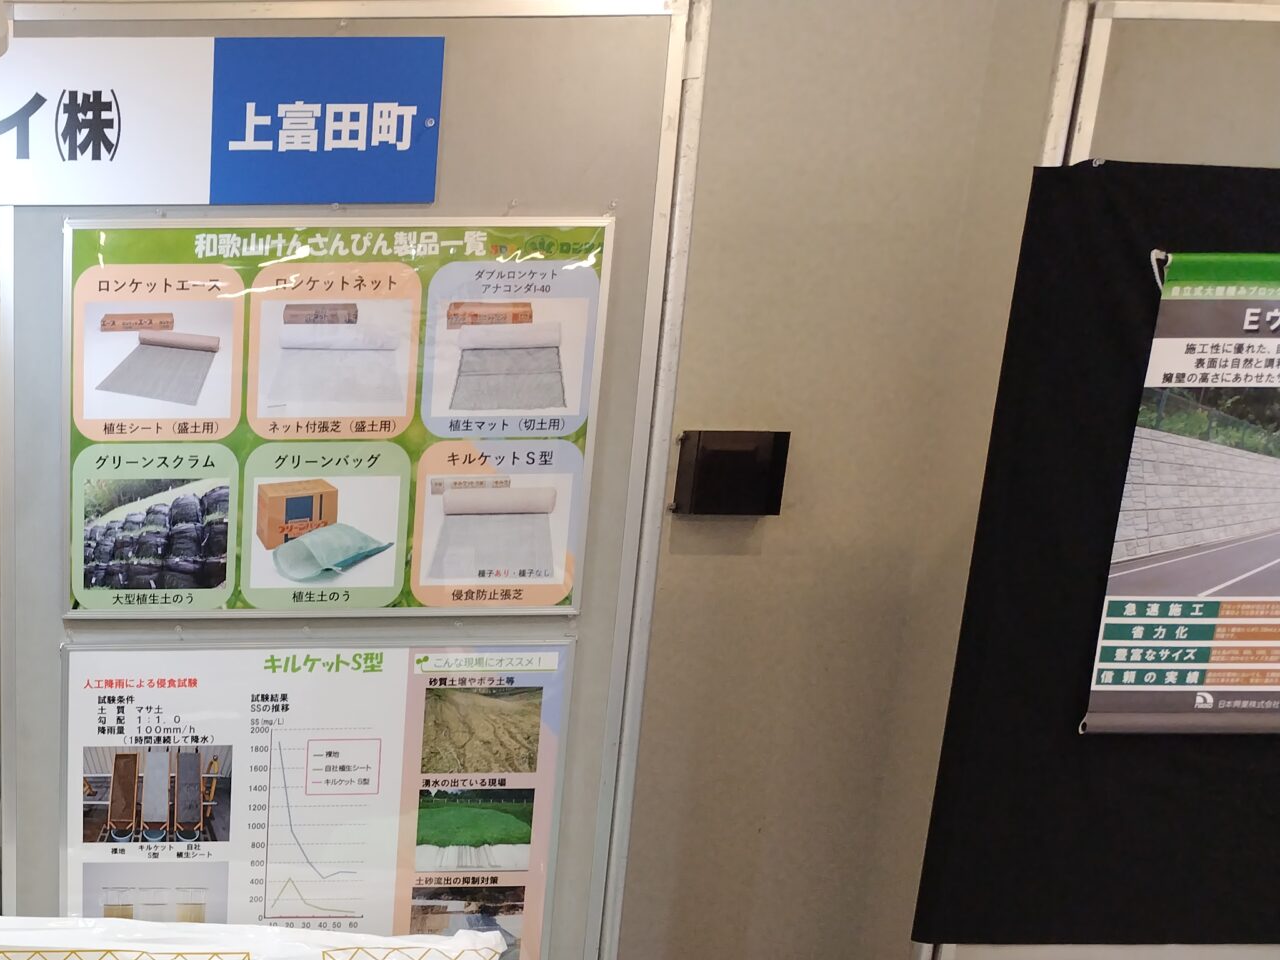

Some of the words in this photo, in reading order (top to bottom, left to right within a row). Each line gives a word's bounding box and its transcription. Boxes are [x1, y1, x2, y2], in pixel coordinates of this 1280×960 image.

[227, 102, 418, 152] 上富田町
[475, 269, 558, 281] ダブルロンケット
[97, 276, 222, 294] ロンケットエース
[275, 275, 398, 292] ロンケットネット
[94, 451, 217, 470] グリーンスクラム
[275, 451, 382, 470] グリーンバッグ
[112, 591, 195, 606] 大型植生土のう
[292, 590, 352, 604] 植生土のう
[451, 588, 524, 602] 侵食防止張芝
[1114, 648, 1198, 661] 豊富なサイズ
[263, 652, 384, 674] キルケットS型
[84, 678, 198, 689] 人工降雨による侵食試験
[98, 695, 135, 704] 試験条件
[251, 694, 288, 703] 試験結果
[136, 705, 163, 714] マサ土
[251, 704, 290, 713] SSの推移
[251, 726, 270, 734] 2000
[247, 822, 266, 830] 1000
